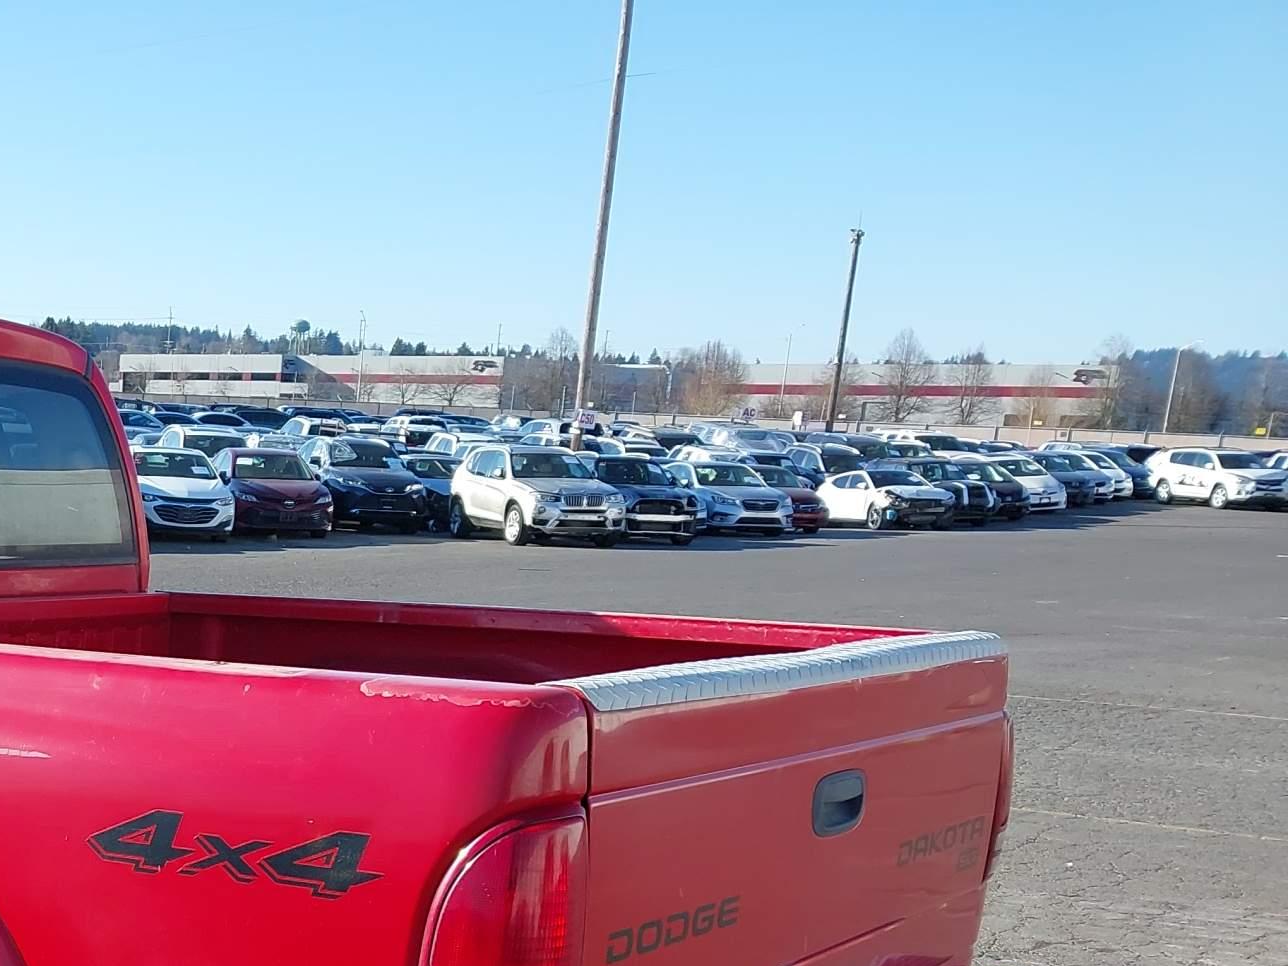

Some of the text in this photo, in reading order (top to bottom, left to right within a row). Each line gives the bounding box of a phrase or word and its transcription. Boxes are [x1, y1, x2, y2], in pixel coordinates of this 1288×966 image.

[742, 407, 756, 417] AC
[896, 815, 986, 867] DAKOTA
[605, 895, 741, 966] DODGE
